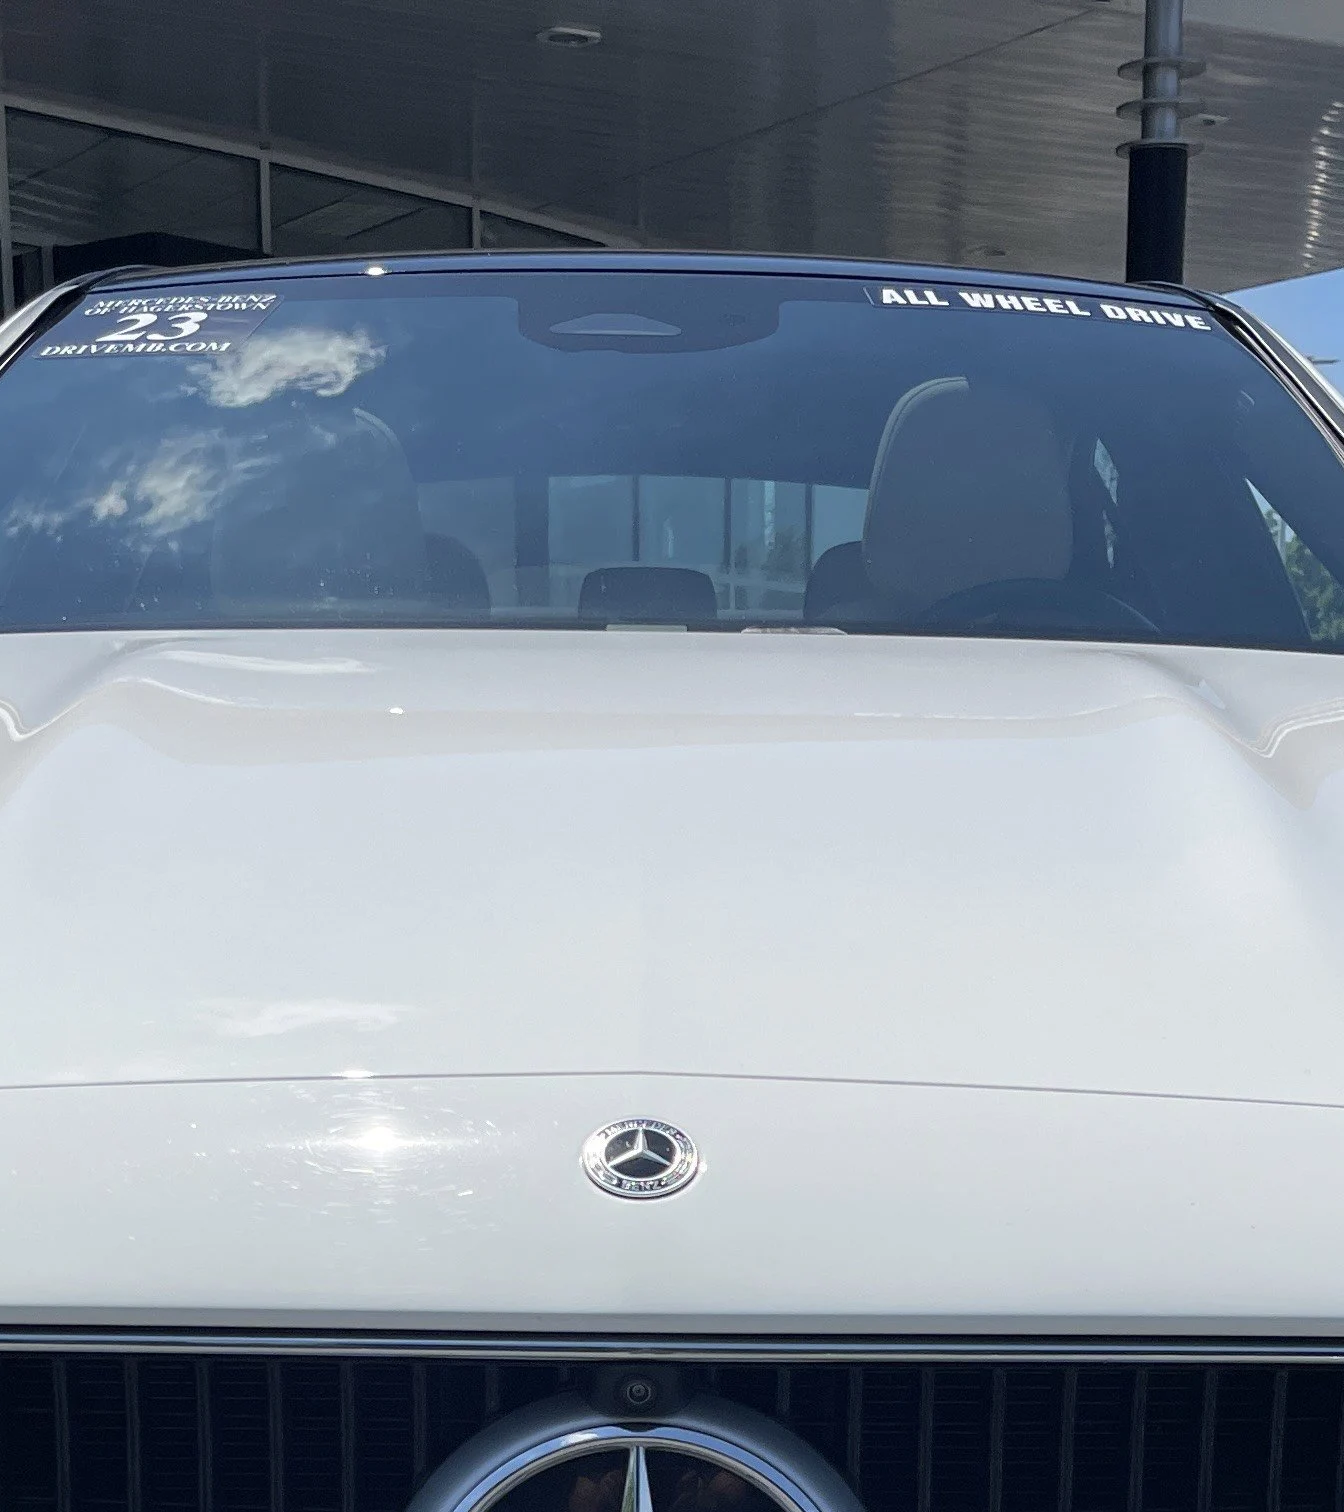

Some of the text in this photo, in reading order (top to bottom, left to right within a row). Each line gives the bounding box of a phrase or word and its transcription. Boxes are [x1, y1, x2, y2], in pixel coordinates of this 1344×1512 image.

[93, 294, 277, 308] MERCEDES-BENZ
[120, 301, 272, 314] HAGERSTOWN
[881, 288, 1212, 331] ALL WHEEL DRIVE
[95, 311, 208, 342] 23
[40, 342, 232, 357] DRIVEMB.COM
